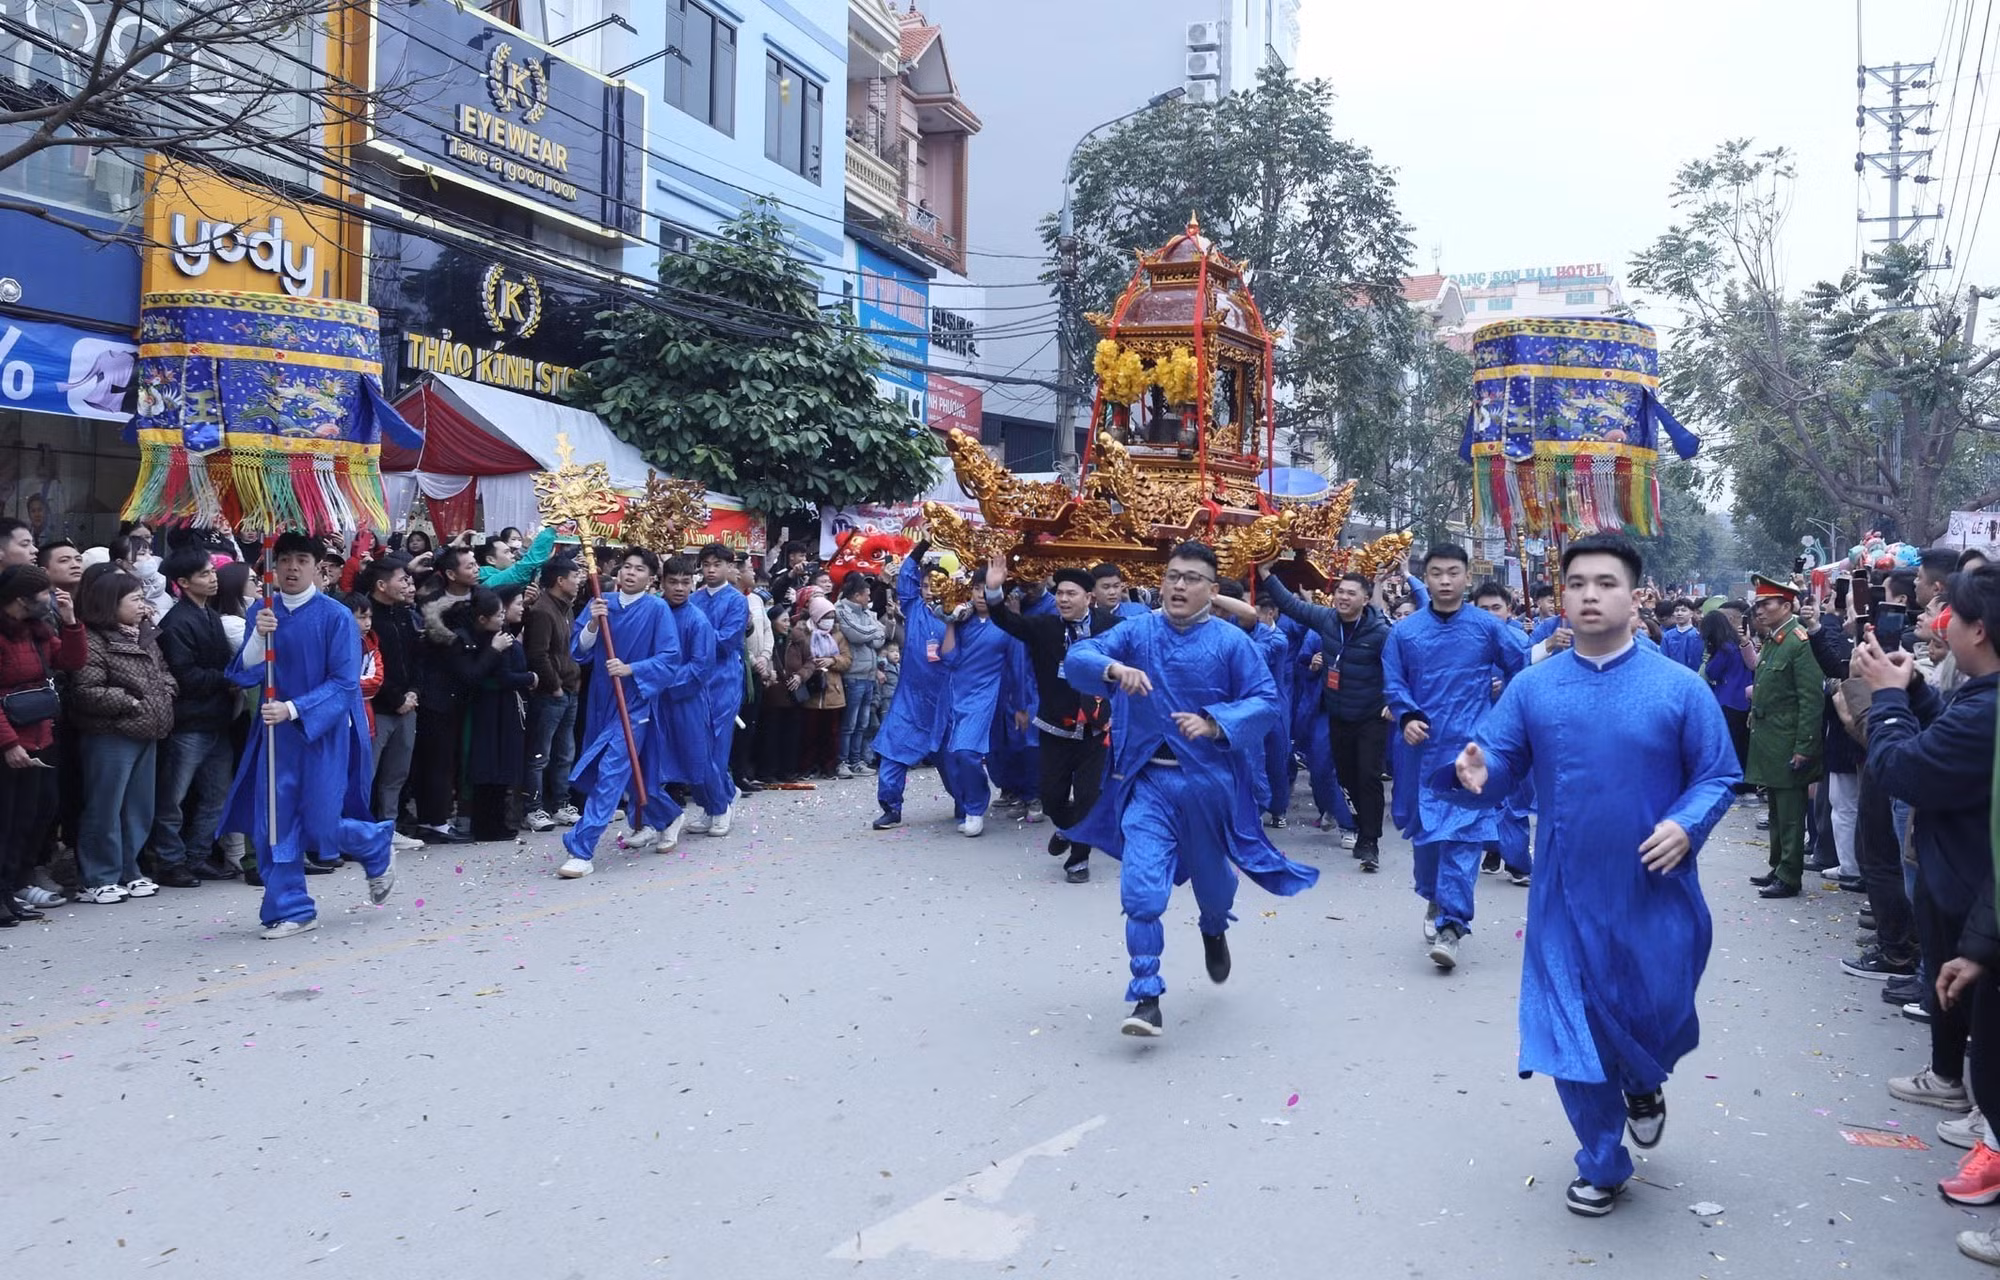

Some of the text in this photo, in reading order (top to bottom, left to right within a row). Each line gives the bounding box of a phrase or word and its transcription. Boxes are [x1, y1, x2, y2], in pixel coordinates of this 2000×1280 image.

[508, 61, 532, 107] K
[450, 136, 488, 166] Take
[505, 162, 545, 188] good
[545, 176, 577, 200] look
[460, 104, 569, 172] EYEWEAR
[171, 212, 314, 296] yody
[1556, 263, 1604, 278] HOTEL
[500, 280, 525, 322] K
[404, 328, 473, 377] THẢO
[476, 341, 533, 390] KÍNH
